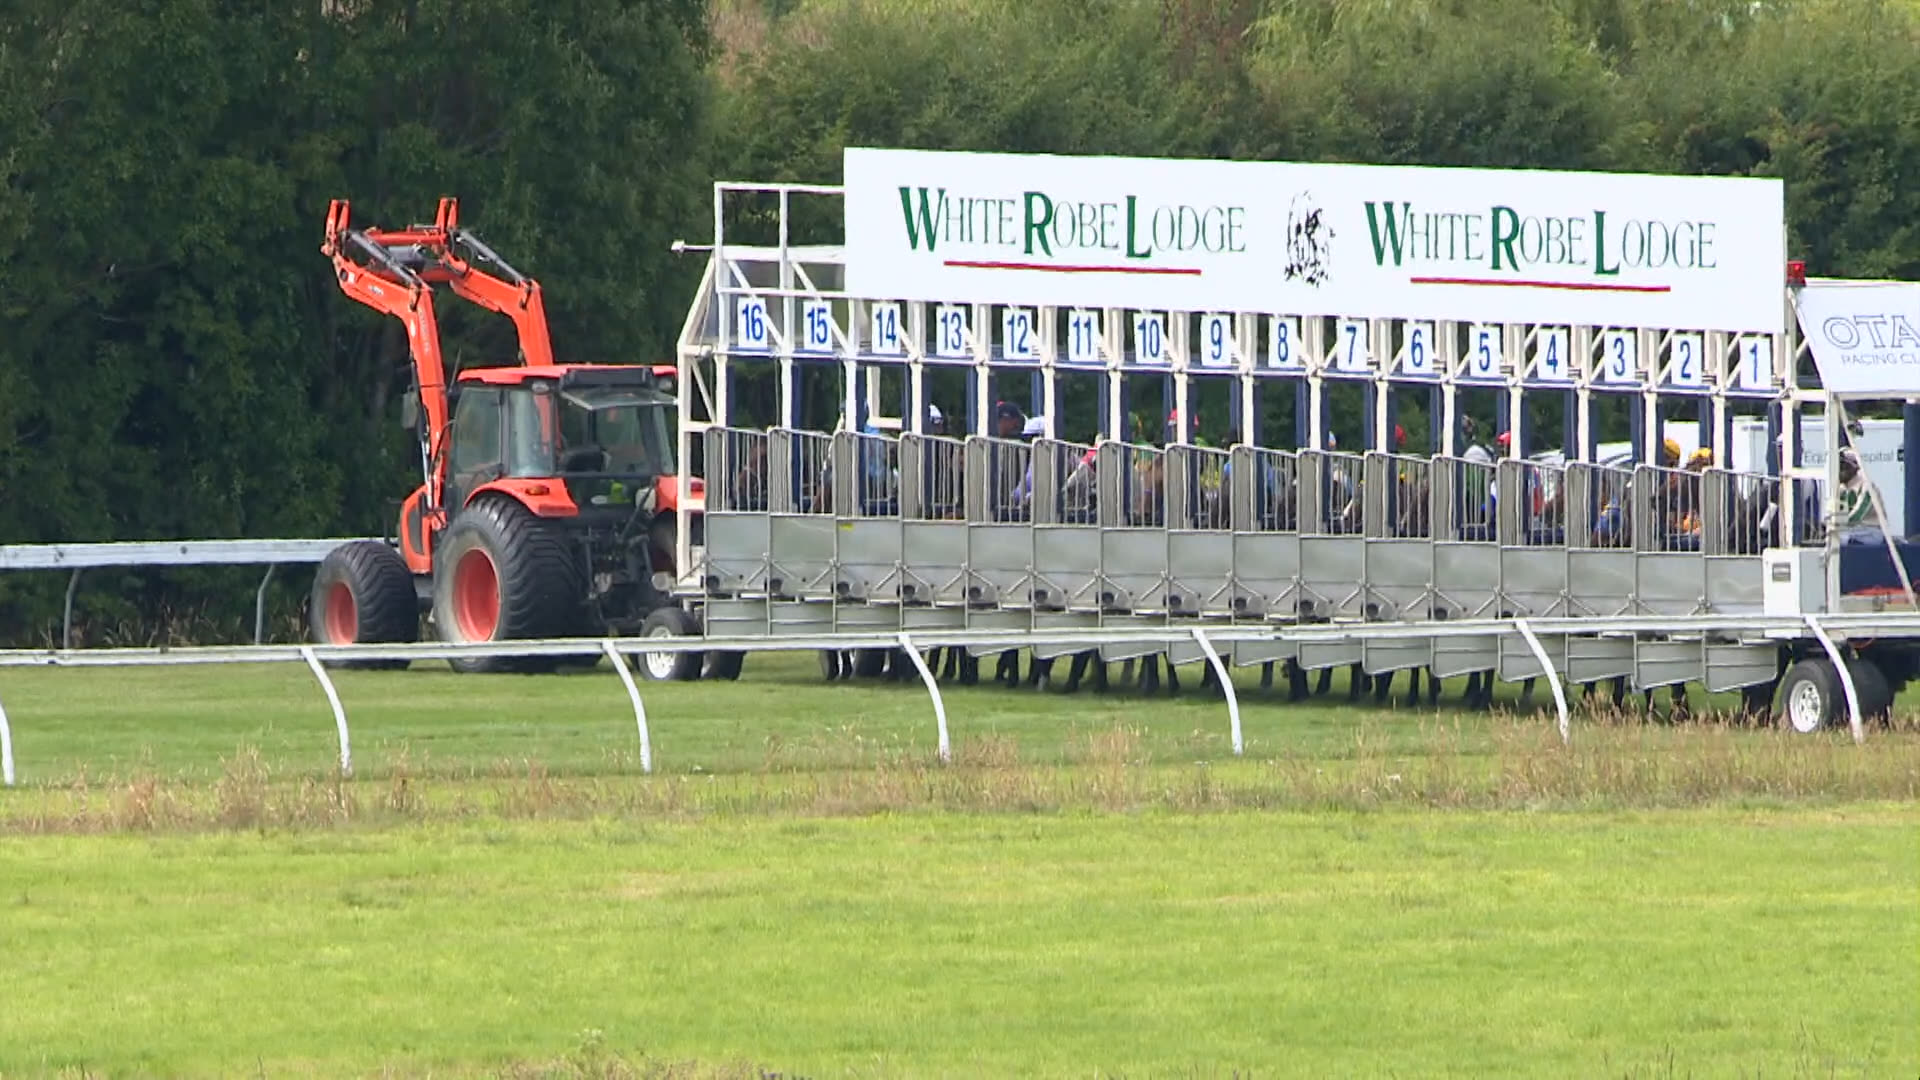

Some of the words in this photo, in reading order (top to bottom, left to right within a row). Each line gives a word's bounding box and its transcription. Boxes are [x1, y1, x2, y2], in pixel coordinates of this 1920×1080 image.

[898, 186, 1016, 252] WHITE
[1023, 191, 1119, 257] ROBE
[1125, 195, 1247, 258] LODGE
[1364, 201, 1484, 266] WHITE
[1489, 206, 1587, 271] ROBE
[1593, 210, 1717, 275] LODGE
[742, 304, 763, 341] 16
[807, 307, 828, 344] 15
[876, 308, 897, 347] 14
[941, 312, 962, 350] 13
[1007, 314, 1028, 353] 12
[1073, 316, 1092, 355] 11
[1138, 318, 1160, 358] 10
[1211, 319, 1222, 360] 9
[1278, 322, 1288, 362] 8
[1346, 326, 1357, 365] 7
[1411, 329, 1423, 367] 6
[1479, 333, 1490, 371] 5
[1546, 334, 1558, 374] 4
[1613, 337, 1625, 376] 3
[1680, 340, 1691, 379] 2
[1750, 343, 1758, 384] 1
[1841, 353, 1897, 365] RACING
